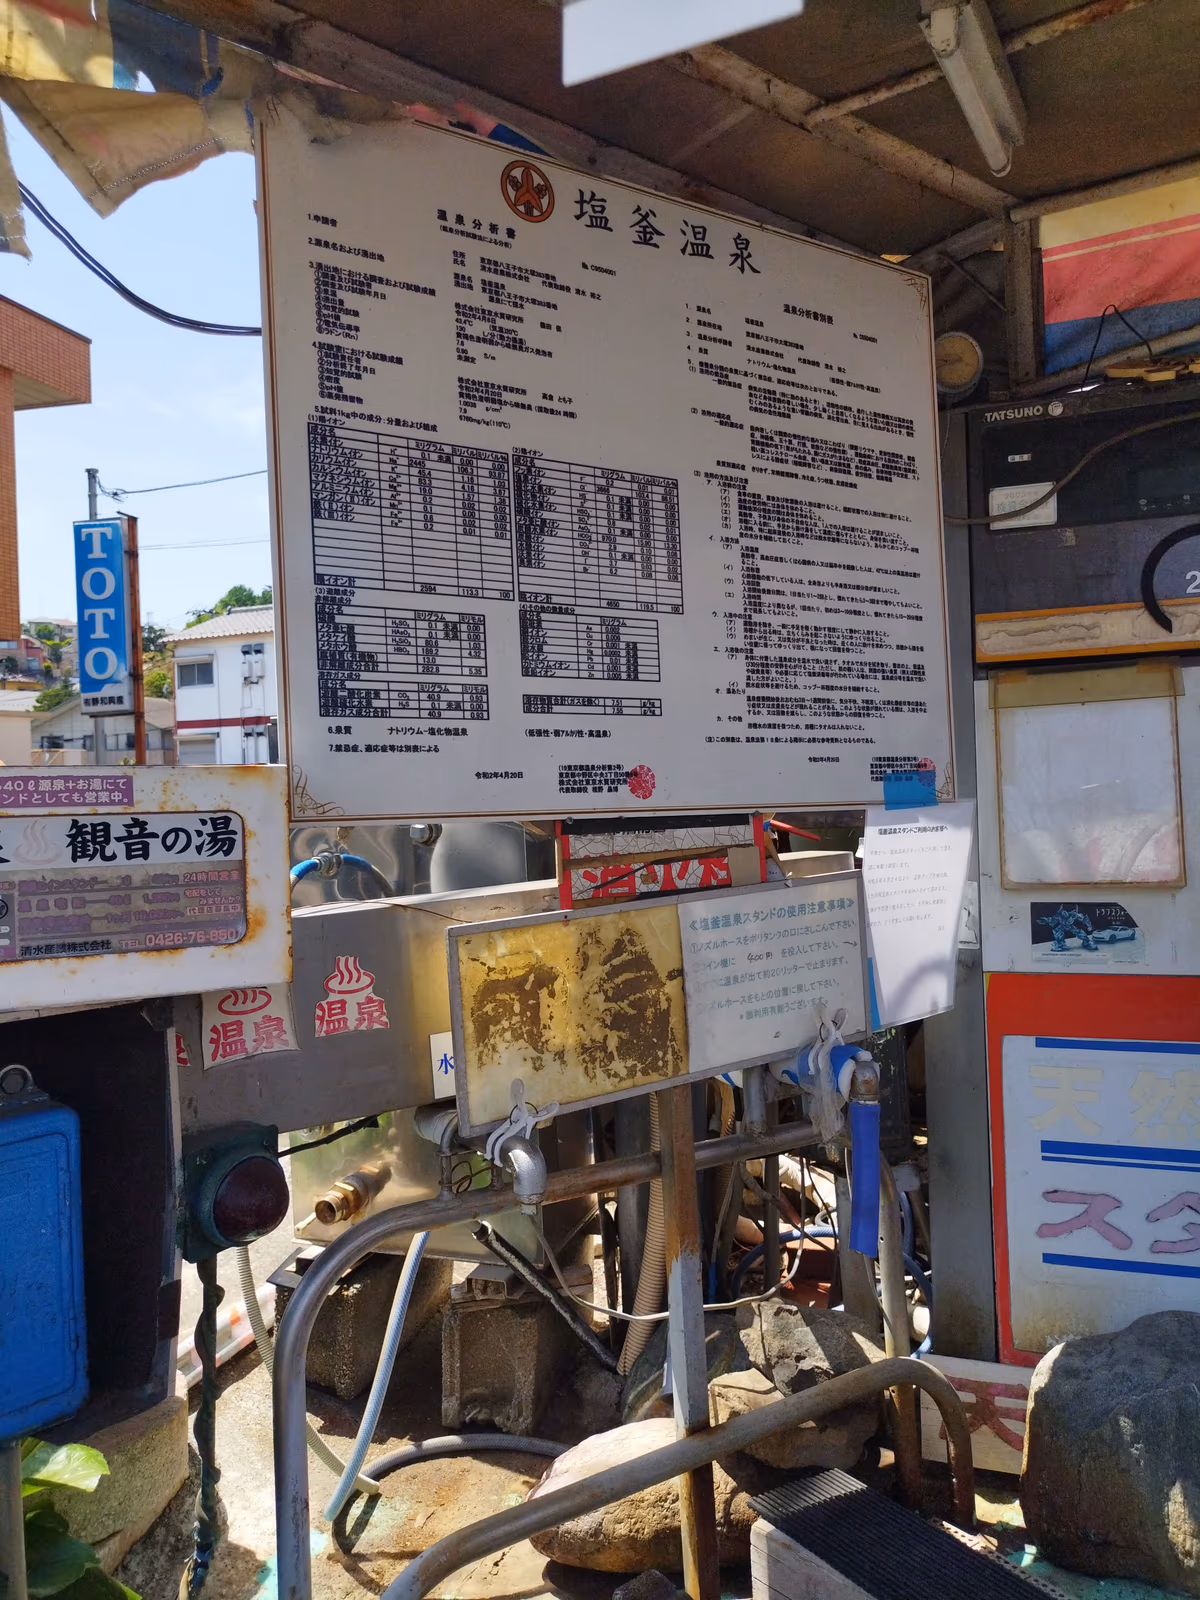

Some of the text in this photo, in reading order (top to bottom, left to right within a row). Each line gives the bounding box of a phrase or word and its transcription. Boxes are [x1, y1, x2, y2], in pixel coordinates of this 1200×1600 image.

[574, 188, 761, 275] 塩釜温泉
[985, 405, 1043, 422] TATSUNO
[410, 459, 425, 467] 2445
[81, 527, 117, 680] TOTO
[328, 726, 351, 734] 6.泉質
[475, 771, 523, 779] 令和2年4月20日
[65, 815, 238, 863] 観音の湯
[183, 870, 240, 883] 24時間営業
[315, 996, 389, 1037] 温泉
[209, 1014, 290, 1063] 温泉
